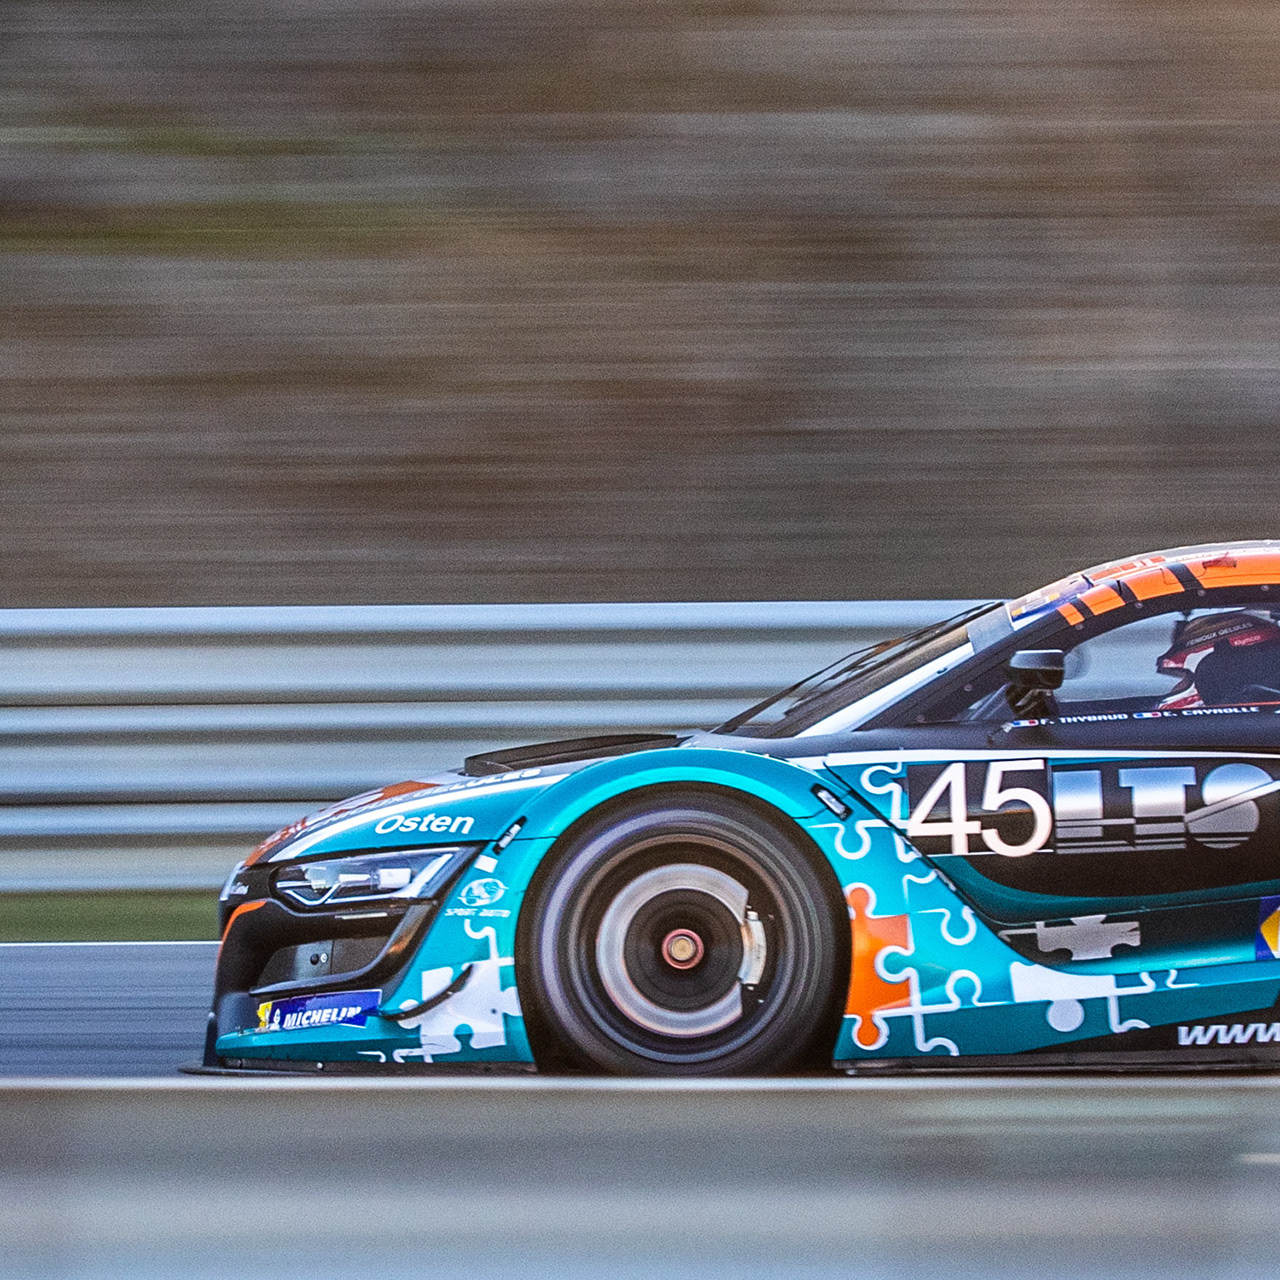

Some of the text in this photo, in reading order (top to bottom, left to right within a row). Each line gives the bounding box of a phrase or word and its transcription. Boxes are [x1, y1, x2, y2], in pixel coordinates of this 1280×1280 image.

[907, 759, 1053, 857] 45
[375, 813, 475, 835] Osten
[282, 1006, 362, 1030] MICHELIN
